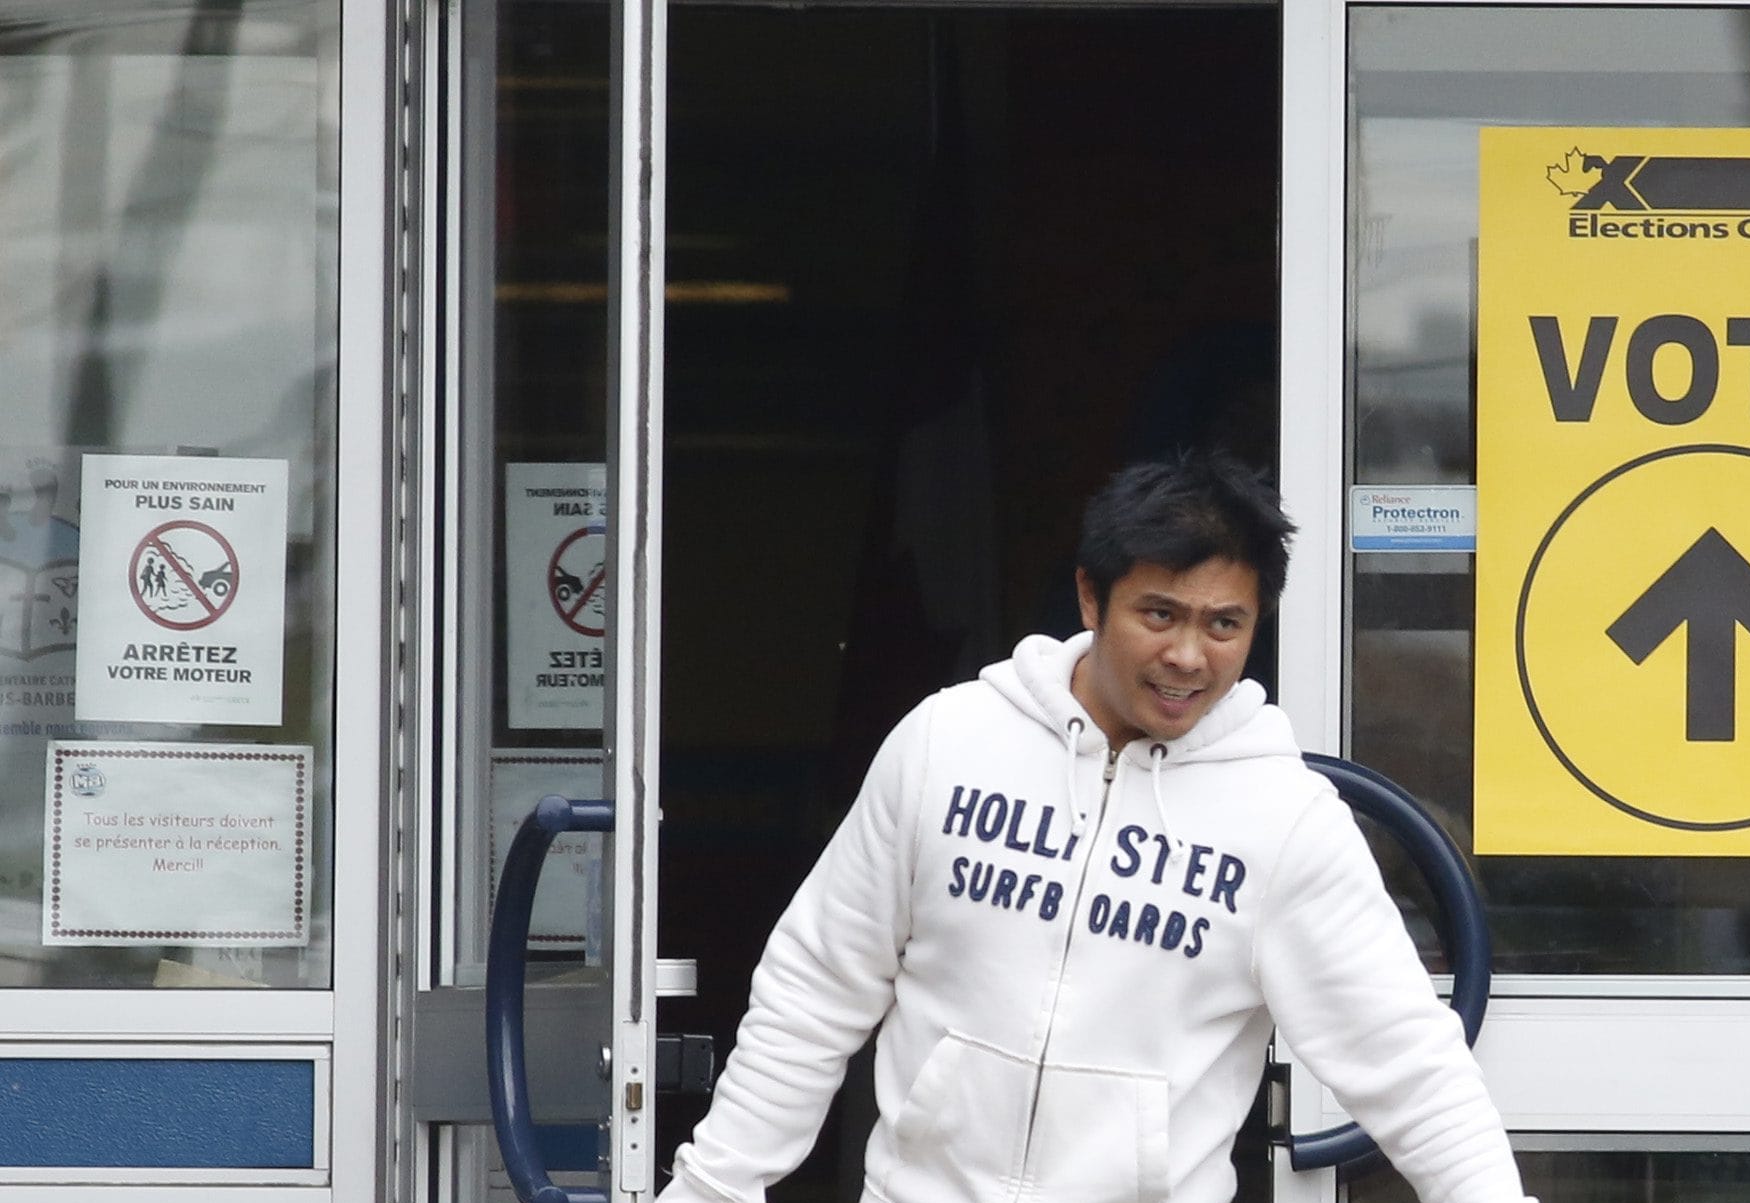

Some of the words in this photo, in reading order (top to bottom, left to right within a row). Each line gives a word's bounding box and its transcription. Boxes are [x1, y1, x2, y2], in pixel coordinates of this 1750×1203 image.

[1569, 214, 1729, 239] Elections
[104, 479, 139, 489] POUR
[142, 480, 159, 490] UN
[162, 481, 267, 494] ENVIRONNEMENT
[135, 495, 183, 509] PLUS
[189, 497, 235, 511] SAIN
[1371, 494, 1411, 505] Reliance
[1372, 505, 1460, 519] Protectron
[122, 641, 238, 664] ARRÊTEZ
[107, 665, 168, 681] VOTRE
[173, 667, 252, 684] MOTEUR
[83, 812, 118, 827] Tous
[123, 813, 144, 827] les
[149, 813, 214, 828] visiteurs
[220, 814, 275, 829] doivent
[74, 836, 91, 849] se
[96, 834, 170, 852] présenter
[176, 835, 185, 850] à
[189, 836, 202, 850] la
[206, 836, 282, 854] réception.
[943, 785, 1246, 914] HOLLISTER
[152, 858, 204, 872] Merci!!
[949, 857, 1210, 958] SURFBOARDS
